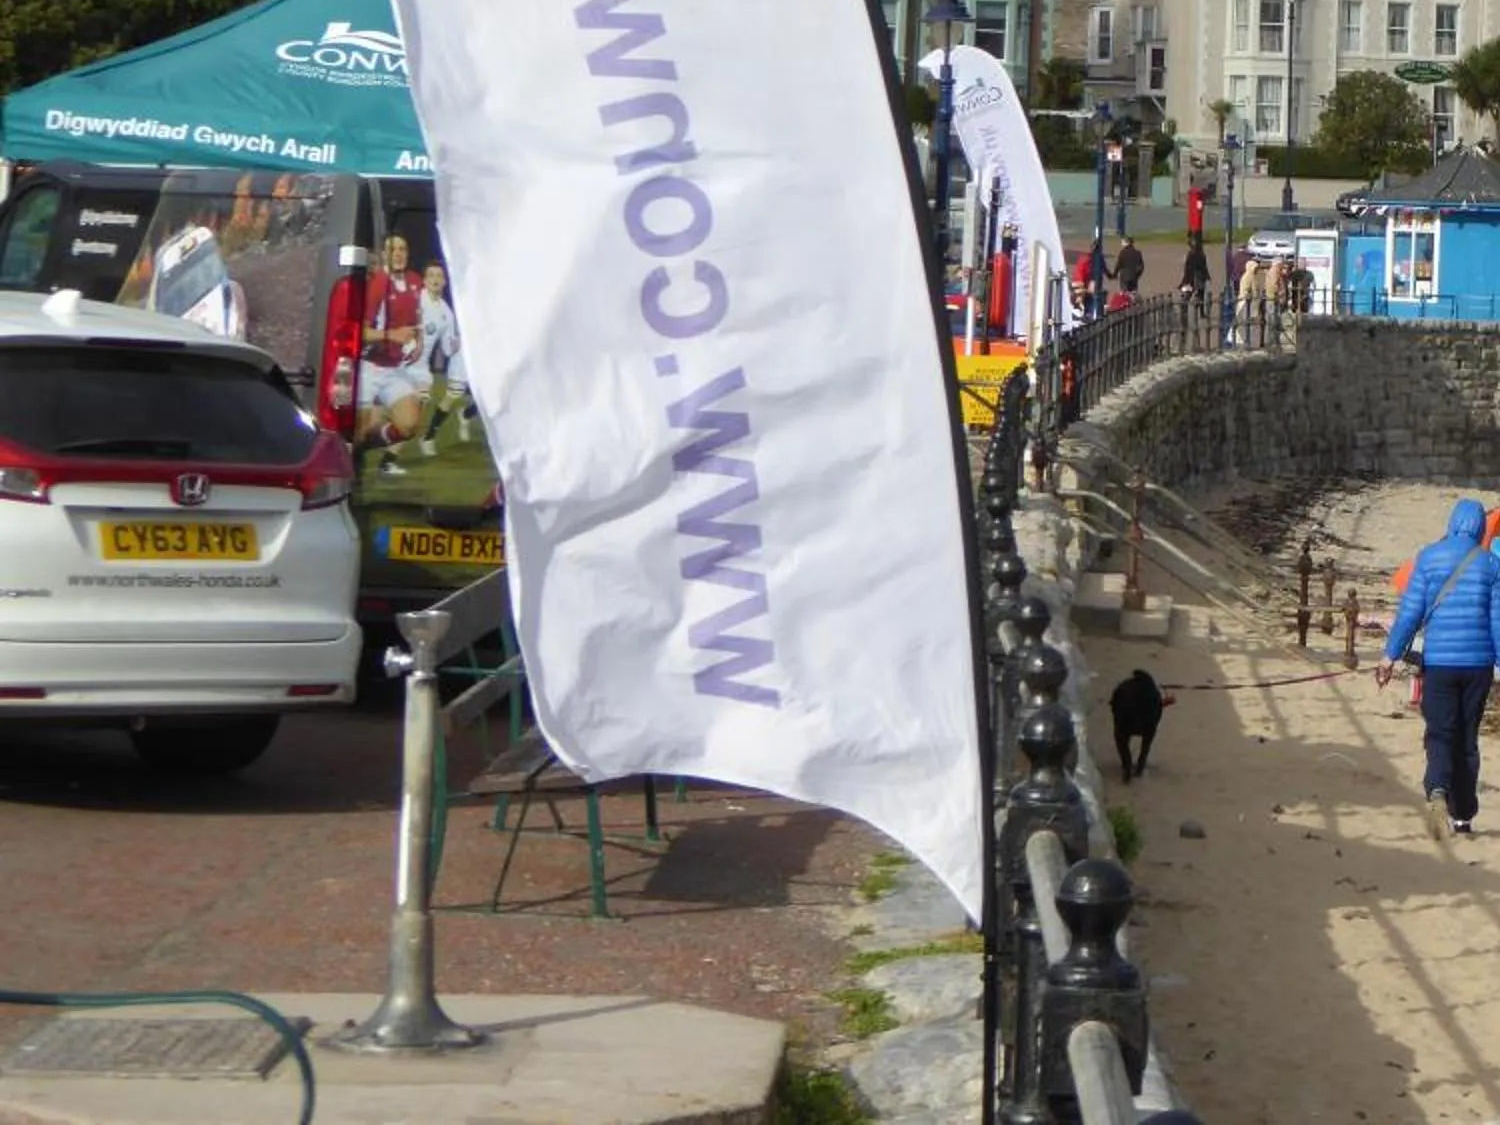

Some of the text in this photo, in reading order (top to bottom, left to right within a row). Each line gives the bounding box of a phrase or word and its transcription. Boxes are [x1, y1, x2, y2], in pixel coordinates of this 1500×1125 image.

[275, 40, 411, 76] CONW
[45, 110, 436, 172] Digwyddiad Gwych Arall An
[112, 524, 249, 554] CY63 AVG
[399, 531, 506, 559] ND61 BXH
